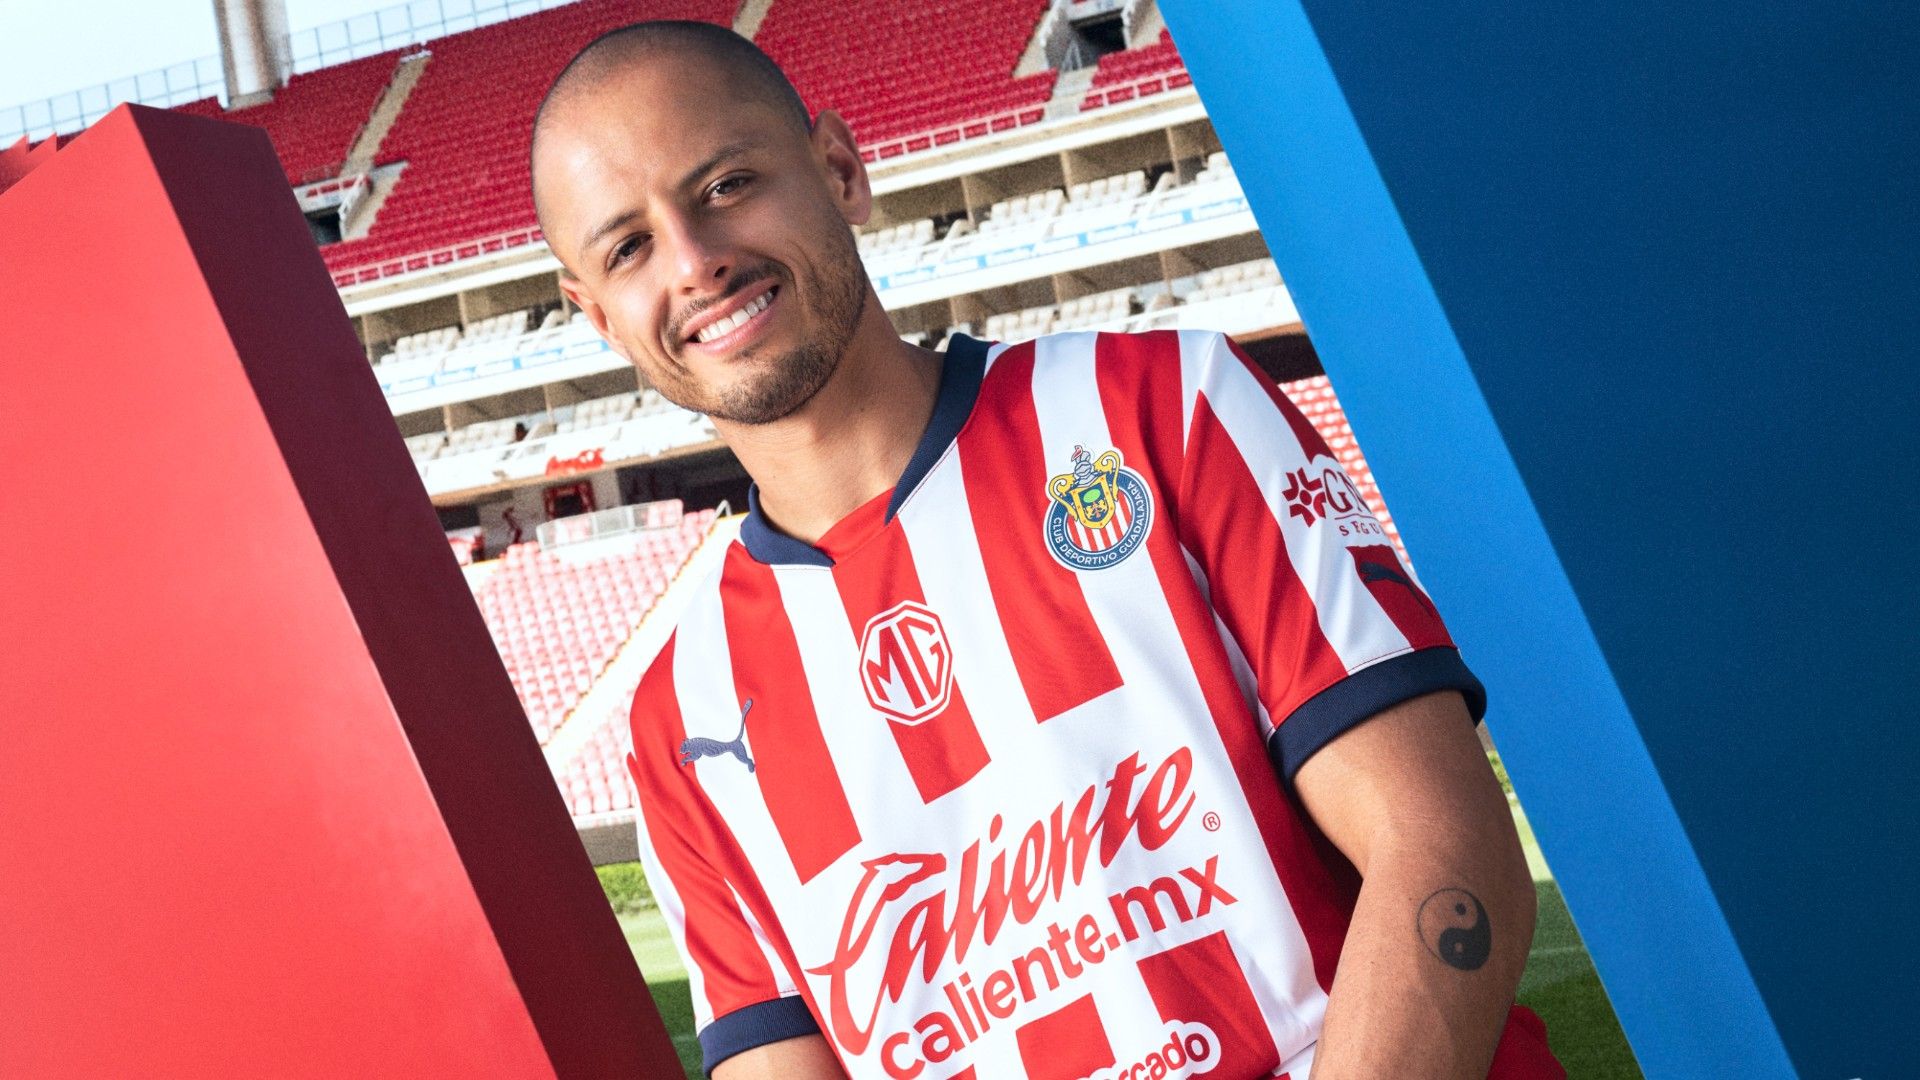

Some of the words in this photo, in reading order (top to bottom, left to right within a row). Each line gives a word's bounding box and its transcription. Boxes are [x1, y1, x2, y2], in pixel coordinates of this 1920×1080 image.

[1053, 517, 1065, 543] CLUB
[1060, 543, 1118, 565] DEPORTIVO
[1118, 480, 1145, 553] GUADALAJARA
[1323, 468, 1372, 513] GN
[1339, 520, 1382, 536] SEGU
[866, 616, 945, 709] MG
[804, 746, 1196, 1056] Caliente
[880, 854, 1239, 1080] caliente.mx
